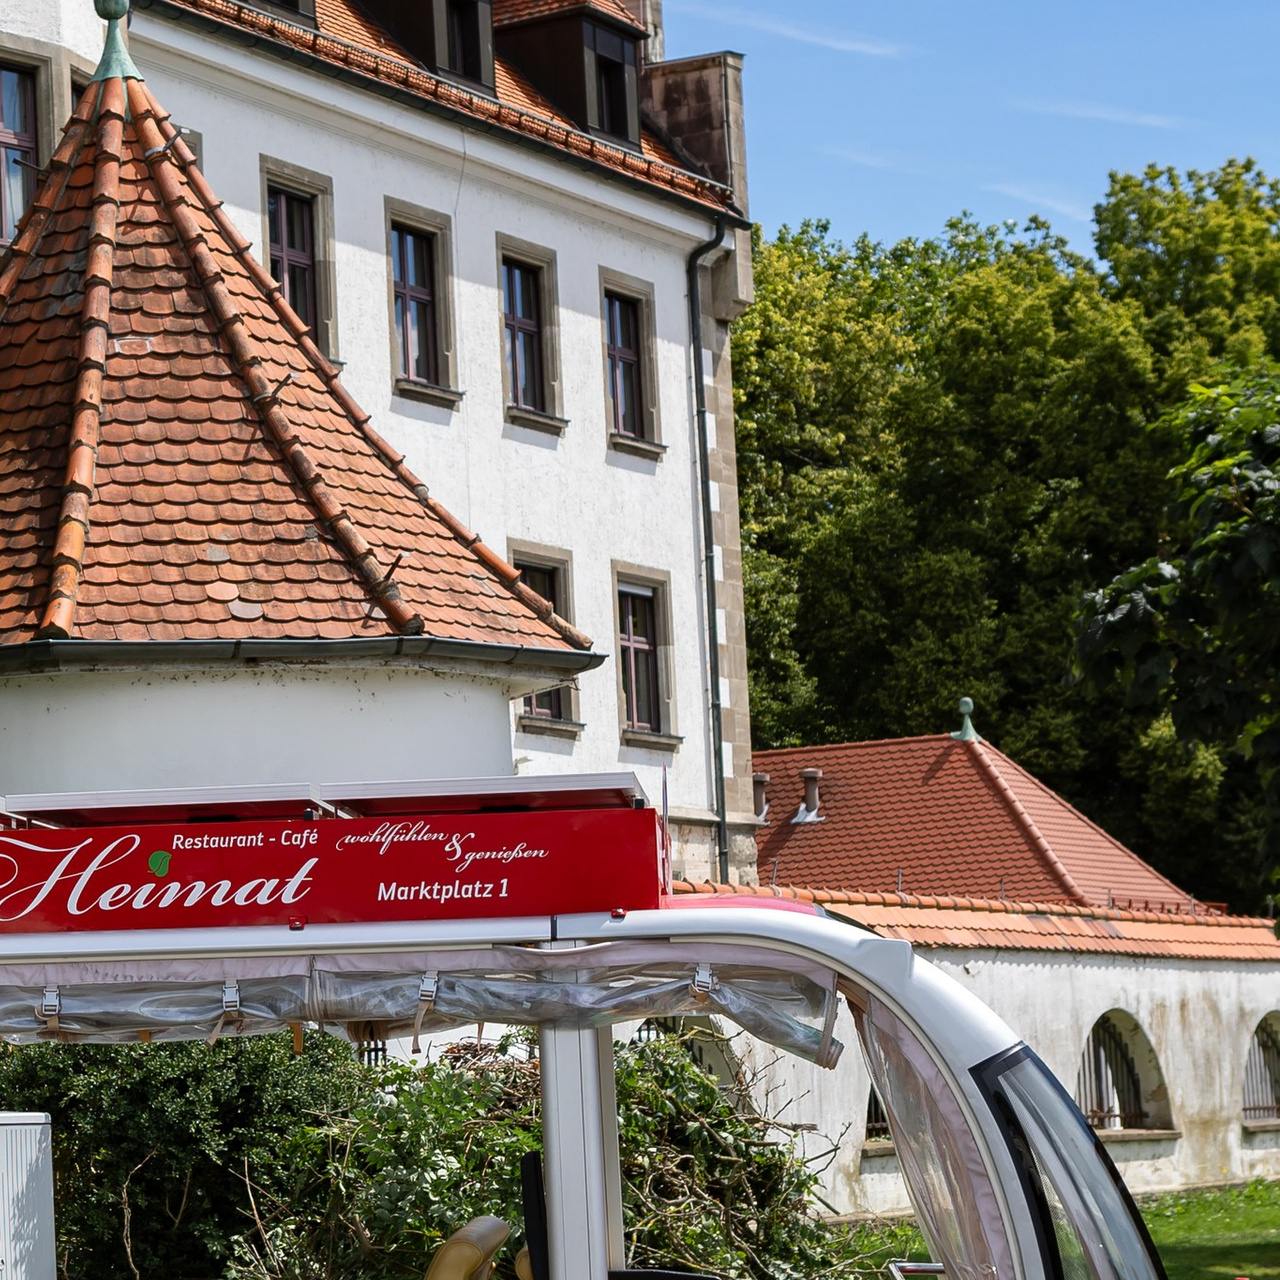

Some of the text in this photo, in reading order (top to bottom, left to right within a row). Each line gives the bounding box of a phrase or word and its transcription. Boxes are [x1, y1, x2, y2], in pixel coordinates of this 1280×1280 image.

[172, 833, 265, 850] Restaurant
[281, 828, 319, 846] Café
[335, 820, 549, 873] wohlfühlen & genießen
[377, 878, 508, 903] Marktplatz 1
